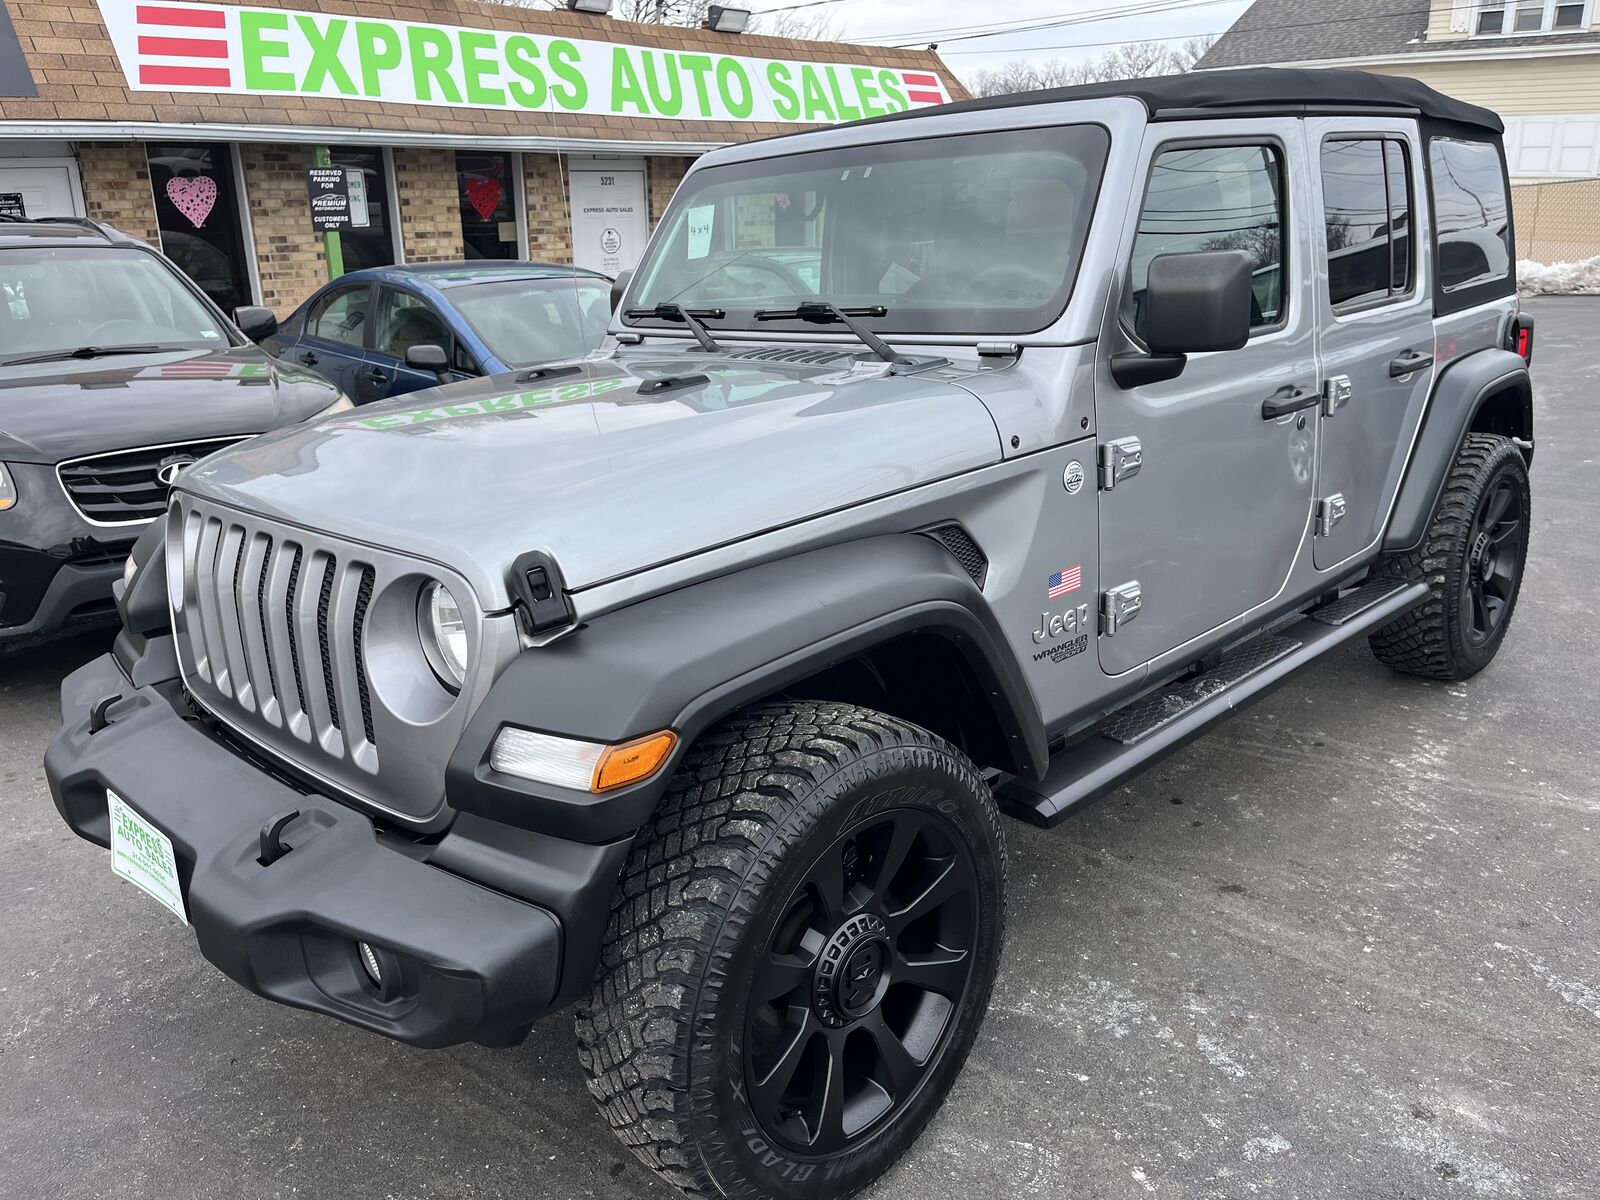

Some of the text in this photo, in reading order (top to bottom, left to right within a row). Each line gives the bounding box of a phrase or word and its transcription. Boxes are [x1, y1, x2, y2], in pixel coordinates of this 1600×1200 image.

[240, 11, 908, 122] EXPRESS AUTO SALES
[600, 176, 615, 186] 5231
[1032, 603, 1088, 645] Jeep
[1032, 633, 1088, 662] WRANGLER
[117, 824, 143, 852] AUTO
[144, 845, 175, 879] SALES
[121, 812, 165, 859] EXPRESS
